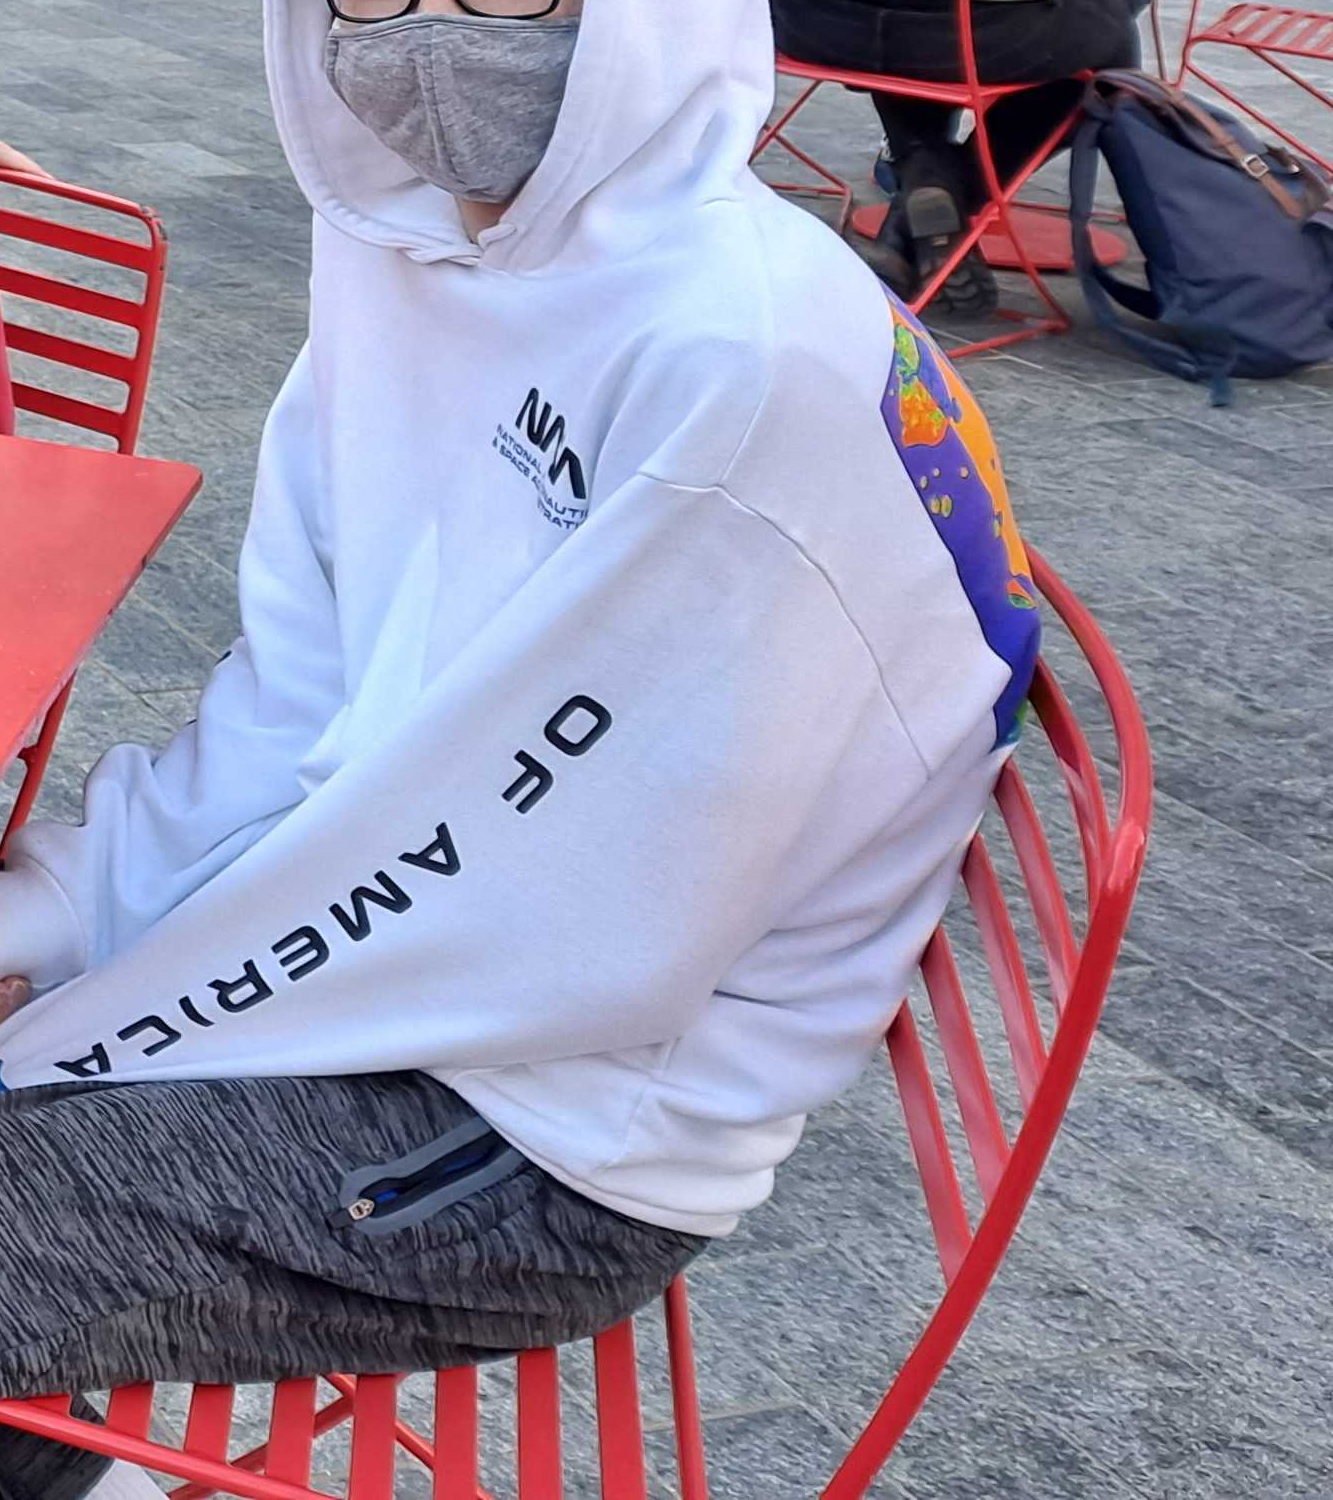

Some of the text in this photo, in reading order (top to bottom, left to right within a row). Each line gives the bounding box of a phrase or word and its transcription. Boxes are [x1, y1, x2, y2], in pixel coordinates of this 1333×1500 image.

[496, 423, 542, 474] NATIONAL
[499, 444, 531, 478] SPACE
[501, 694, 613, 815] OF
[53, 821, 462, 1079] AMERICA
